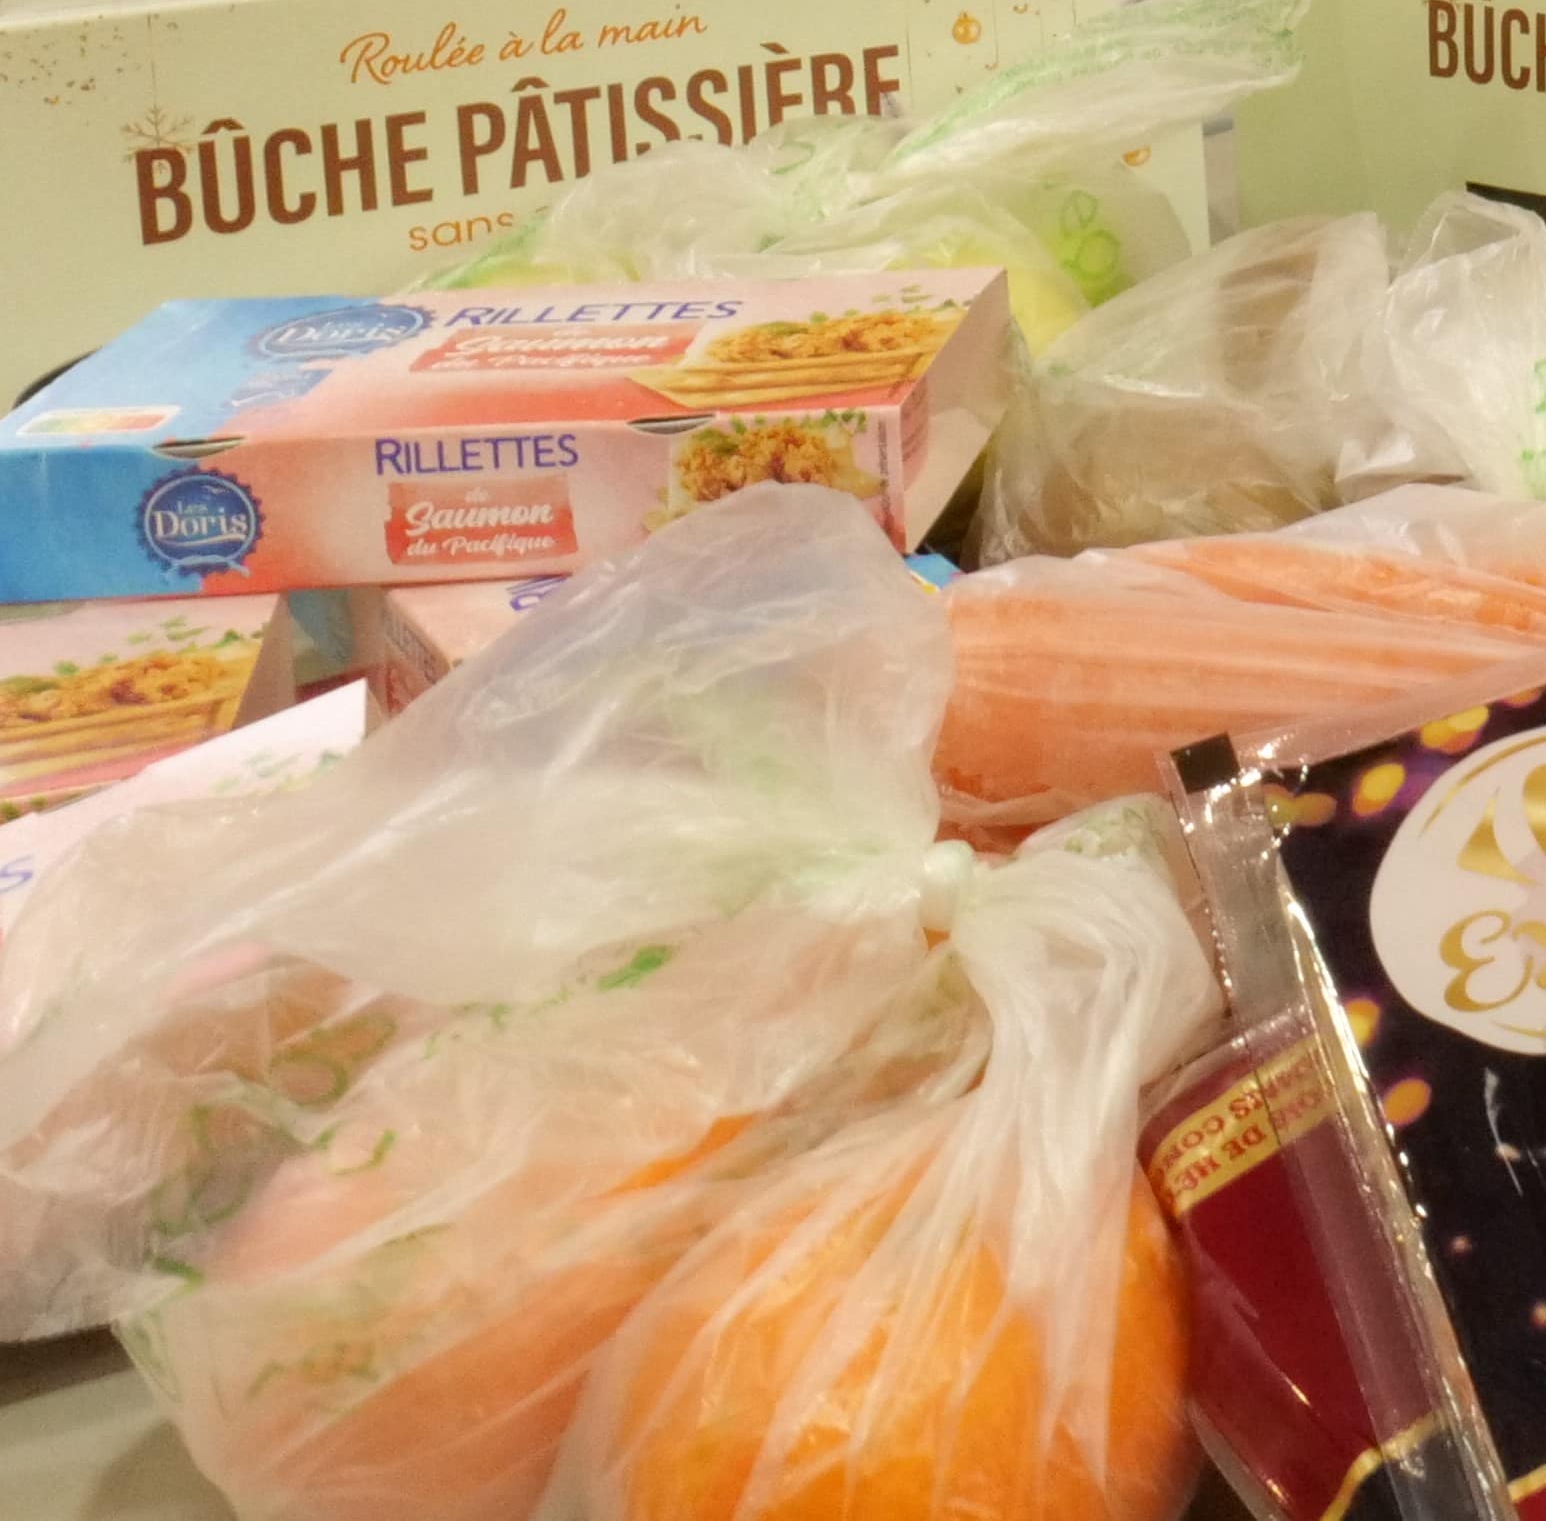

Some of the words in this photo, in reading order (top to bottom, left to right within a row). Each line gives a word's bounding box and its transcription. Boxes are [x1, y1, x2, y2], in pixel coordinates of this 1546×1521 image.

[339, 20, 485, 86] Roulée
[498, 29, 537, 61] à
[540, 7, 585, 56] la
[597, 4, 709, 49] main
[135, 109, 433, 247] BÛCHE
[445, 300, 743, 327] RILLETTES
[374, 433, 579, 477] RILLETTES
[152, 508, 250, 539] Doris
[405, 498, 555, 537] Saumon
[406, 536, 439, 557] du
[448, 530, 556, 558] Pacifique
